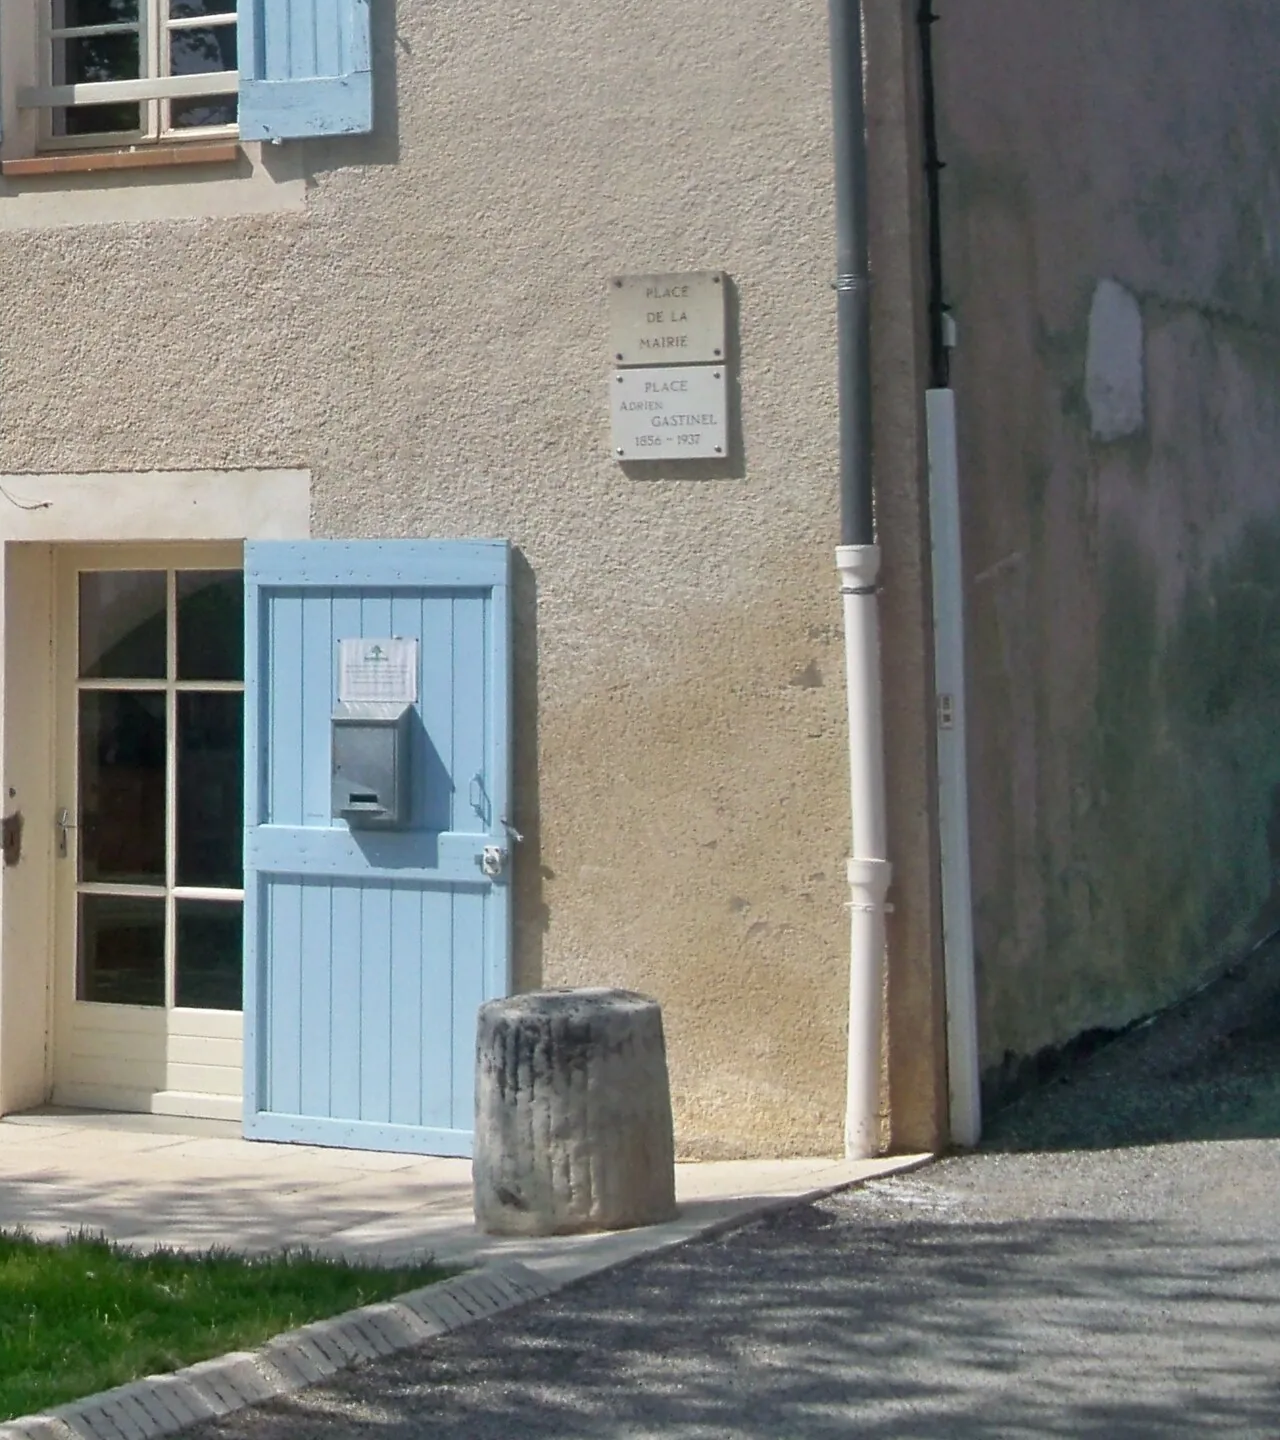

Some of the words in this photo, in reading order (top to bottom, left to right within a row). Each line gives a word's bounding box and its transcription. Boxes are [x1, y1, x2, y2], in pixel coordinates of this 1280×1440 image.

[646, 285, 689, 298] PLACE
[647, 312, 663, 323] DE
[671, 311, 687, 322] LA
[640, 336, 688, 349] MAIRIE
[644, 381, 688, 393] PLACE
[620, 401, 663, 411] ADRIEN
[651, 414, 717, 428] GASTINEL
[635, 436, 661, 447] 1856
[677, 434, 700, 445] 1937
